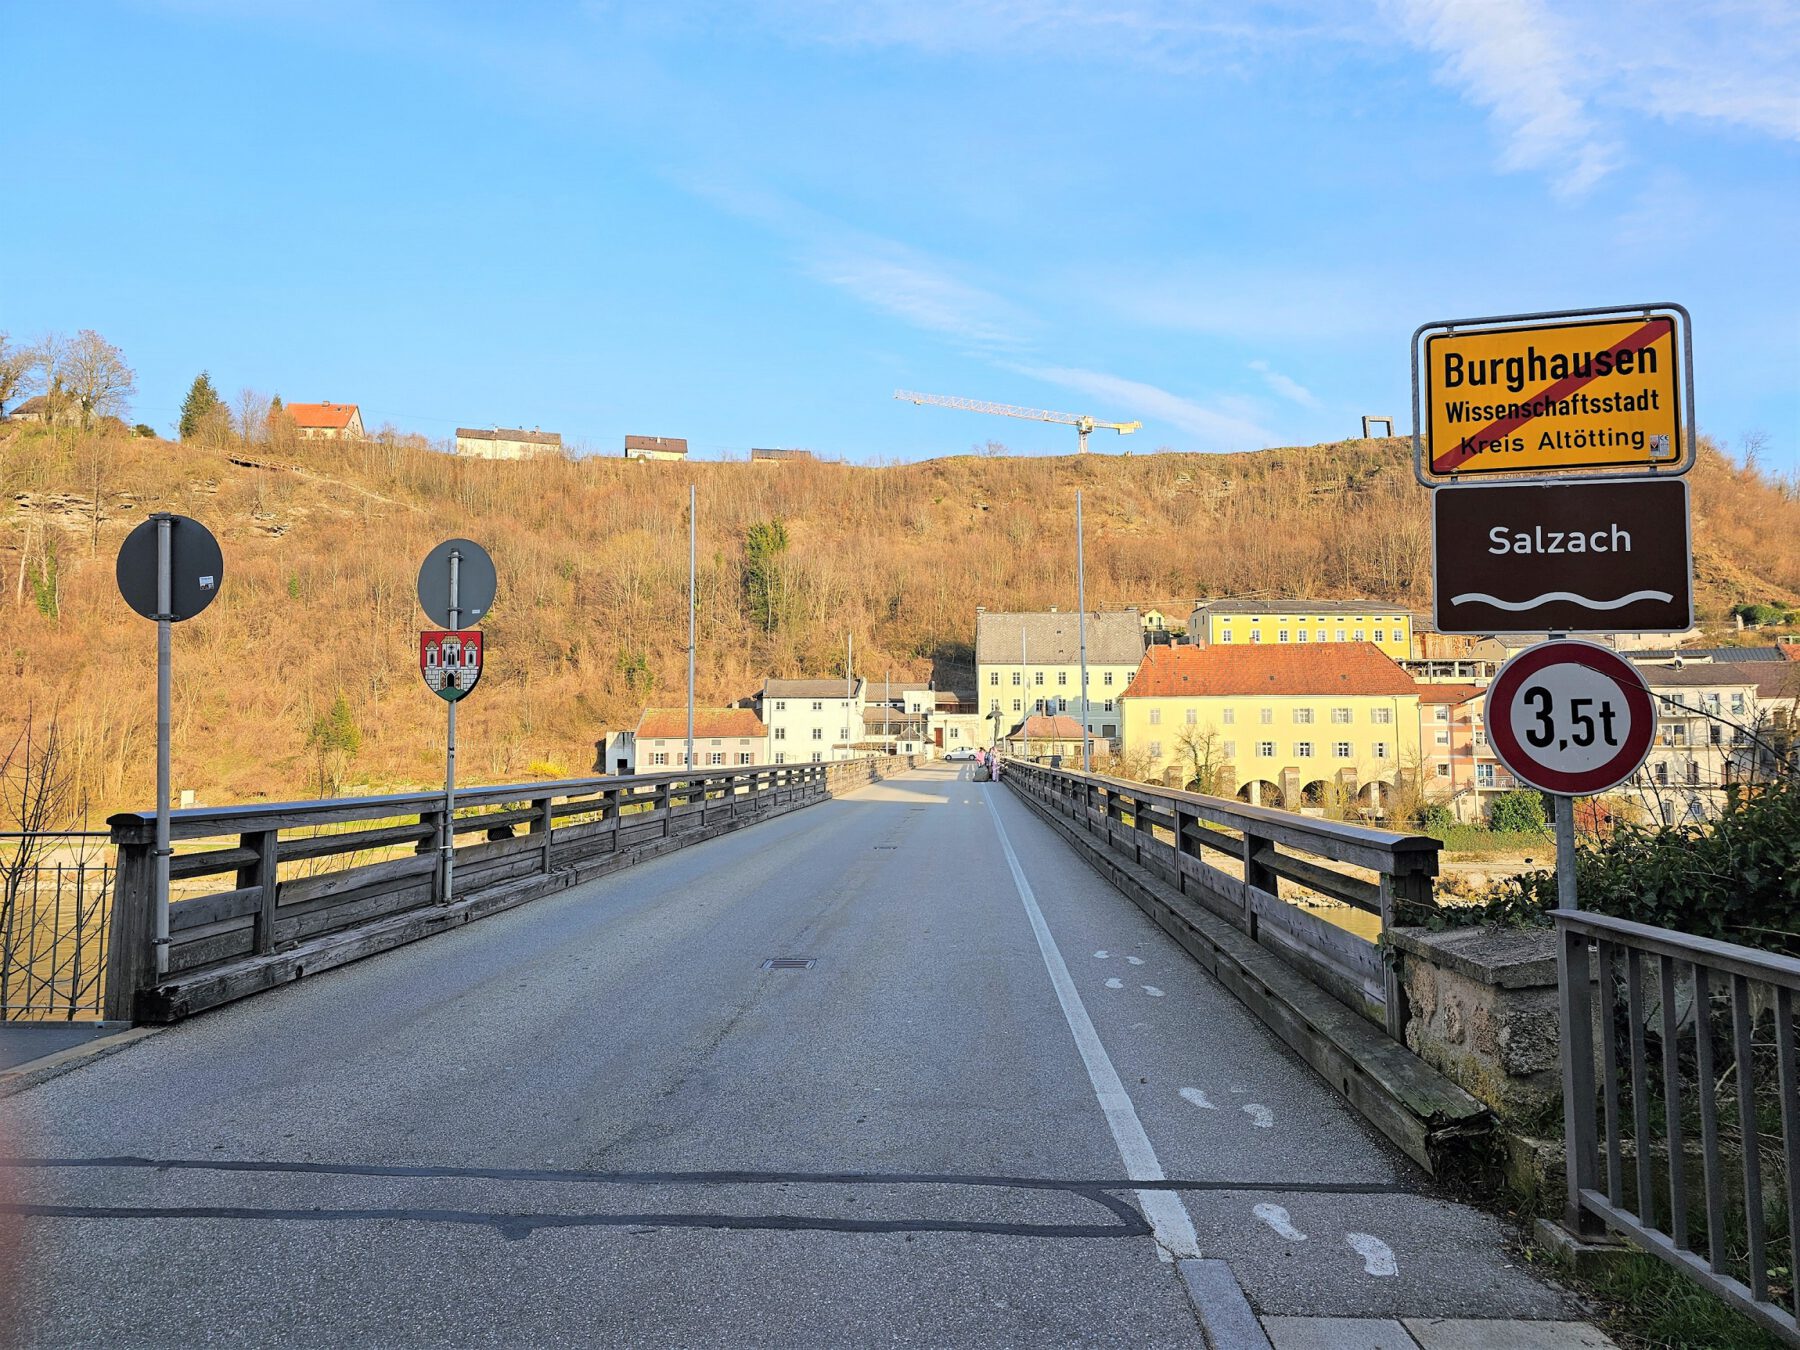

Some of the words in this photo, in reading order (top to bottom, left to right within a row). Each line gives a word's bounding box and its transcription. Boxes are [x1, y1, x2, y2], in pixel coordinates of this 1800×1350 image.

[1444, 346, 1658, 393] Burghausen
[1445, 388, 1660, 423] Wissenschaftsstadt
[1460, 434, 1525, 456] Kreis
[1538, 427, 1645, 451] Altötting
[1487, 523, 1632, 555] Salzach
[1523, 685, 1618, 752] 3,5t
